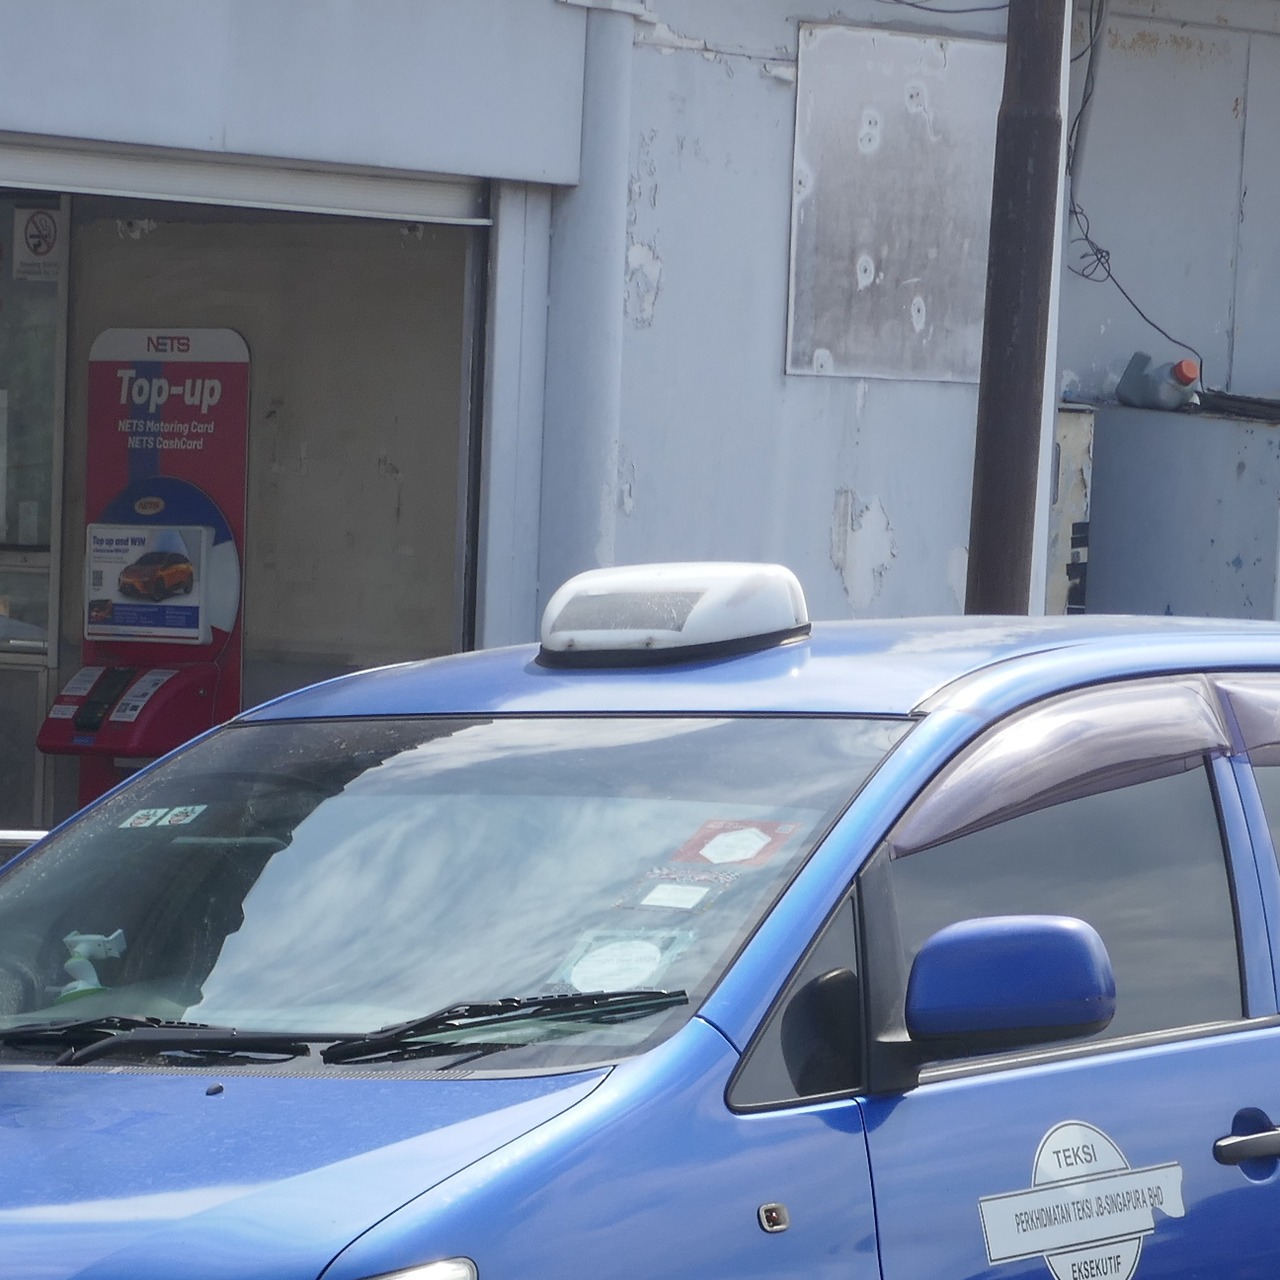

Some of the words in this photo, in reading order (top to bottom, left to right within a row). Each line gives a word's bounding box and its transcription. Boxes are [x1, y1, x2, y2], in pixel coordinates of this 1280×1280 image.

[146, 335, 191, 353] NETS
[116, 368, 222, 415] Top-up
[117, 419, 145, 433] NETS
[145, 420, 189, 436] Motoring
[190, 420, 215, 434] Card
[127, 436, 155, 449] NETS
[155, 436, 204, 450] CashCard
[1052, 1144, 1098, 1169] TEKSI
[1014, 1204, 1072, 1234] PERKHIDMATAN
[1071, 1199, 1094, 1221] TEKSI
[1094, 1189, 1149, 1218] JB-SINGAPURA
[1147, 1185, 1164, 1208] BHD
